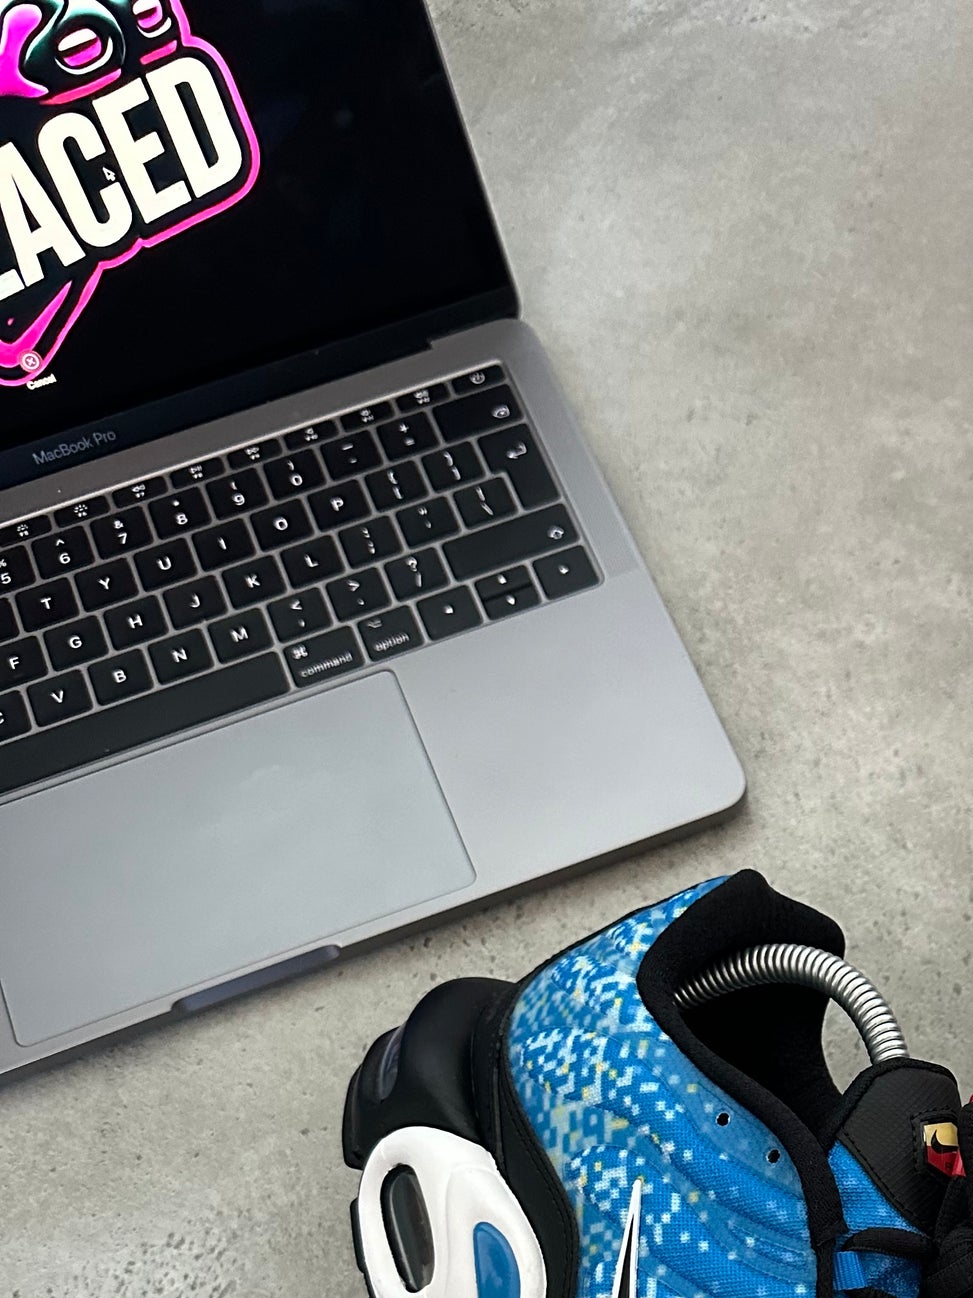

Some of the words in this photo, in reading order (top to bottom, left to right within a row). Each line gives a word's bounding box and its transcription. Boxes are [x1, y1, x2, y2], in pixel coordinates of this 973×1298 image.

[0, 57, 243, 300] ACED
[32, 437, 93, 465] MacBook
[92, 431, 116, 446] Pro
[0, 572, 12, 585] 5
[58, 552, 71, 565] 6
[117, 532, 128, 545] 7
[175, 513, 189, 525] 8
[232, 493, 246, 506] 9
[40, 597, 52, 610] T
[98, 577, 110, 590] Y
[157, 556, 172, 571] U
[274, 517, 289, 531] O
[330, 497, 344, 512] P
[8, 656, 20, 670] F
[68, 635, 83, 649] G
[127, 614, 144, 629] H
[245, 574, 261, 588] K
[374, 633, 410, 651] option
[50, 689, 64, 704] V
[112, 669, 127, 684] B
[171, 648, 188, 663] N
[230, 626, 249, 643] M
[301, 652, 353, 678] command
